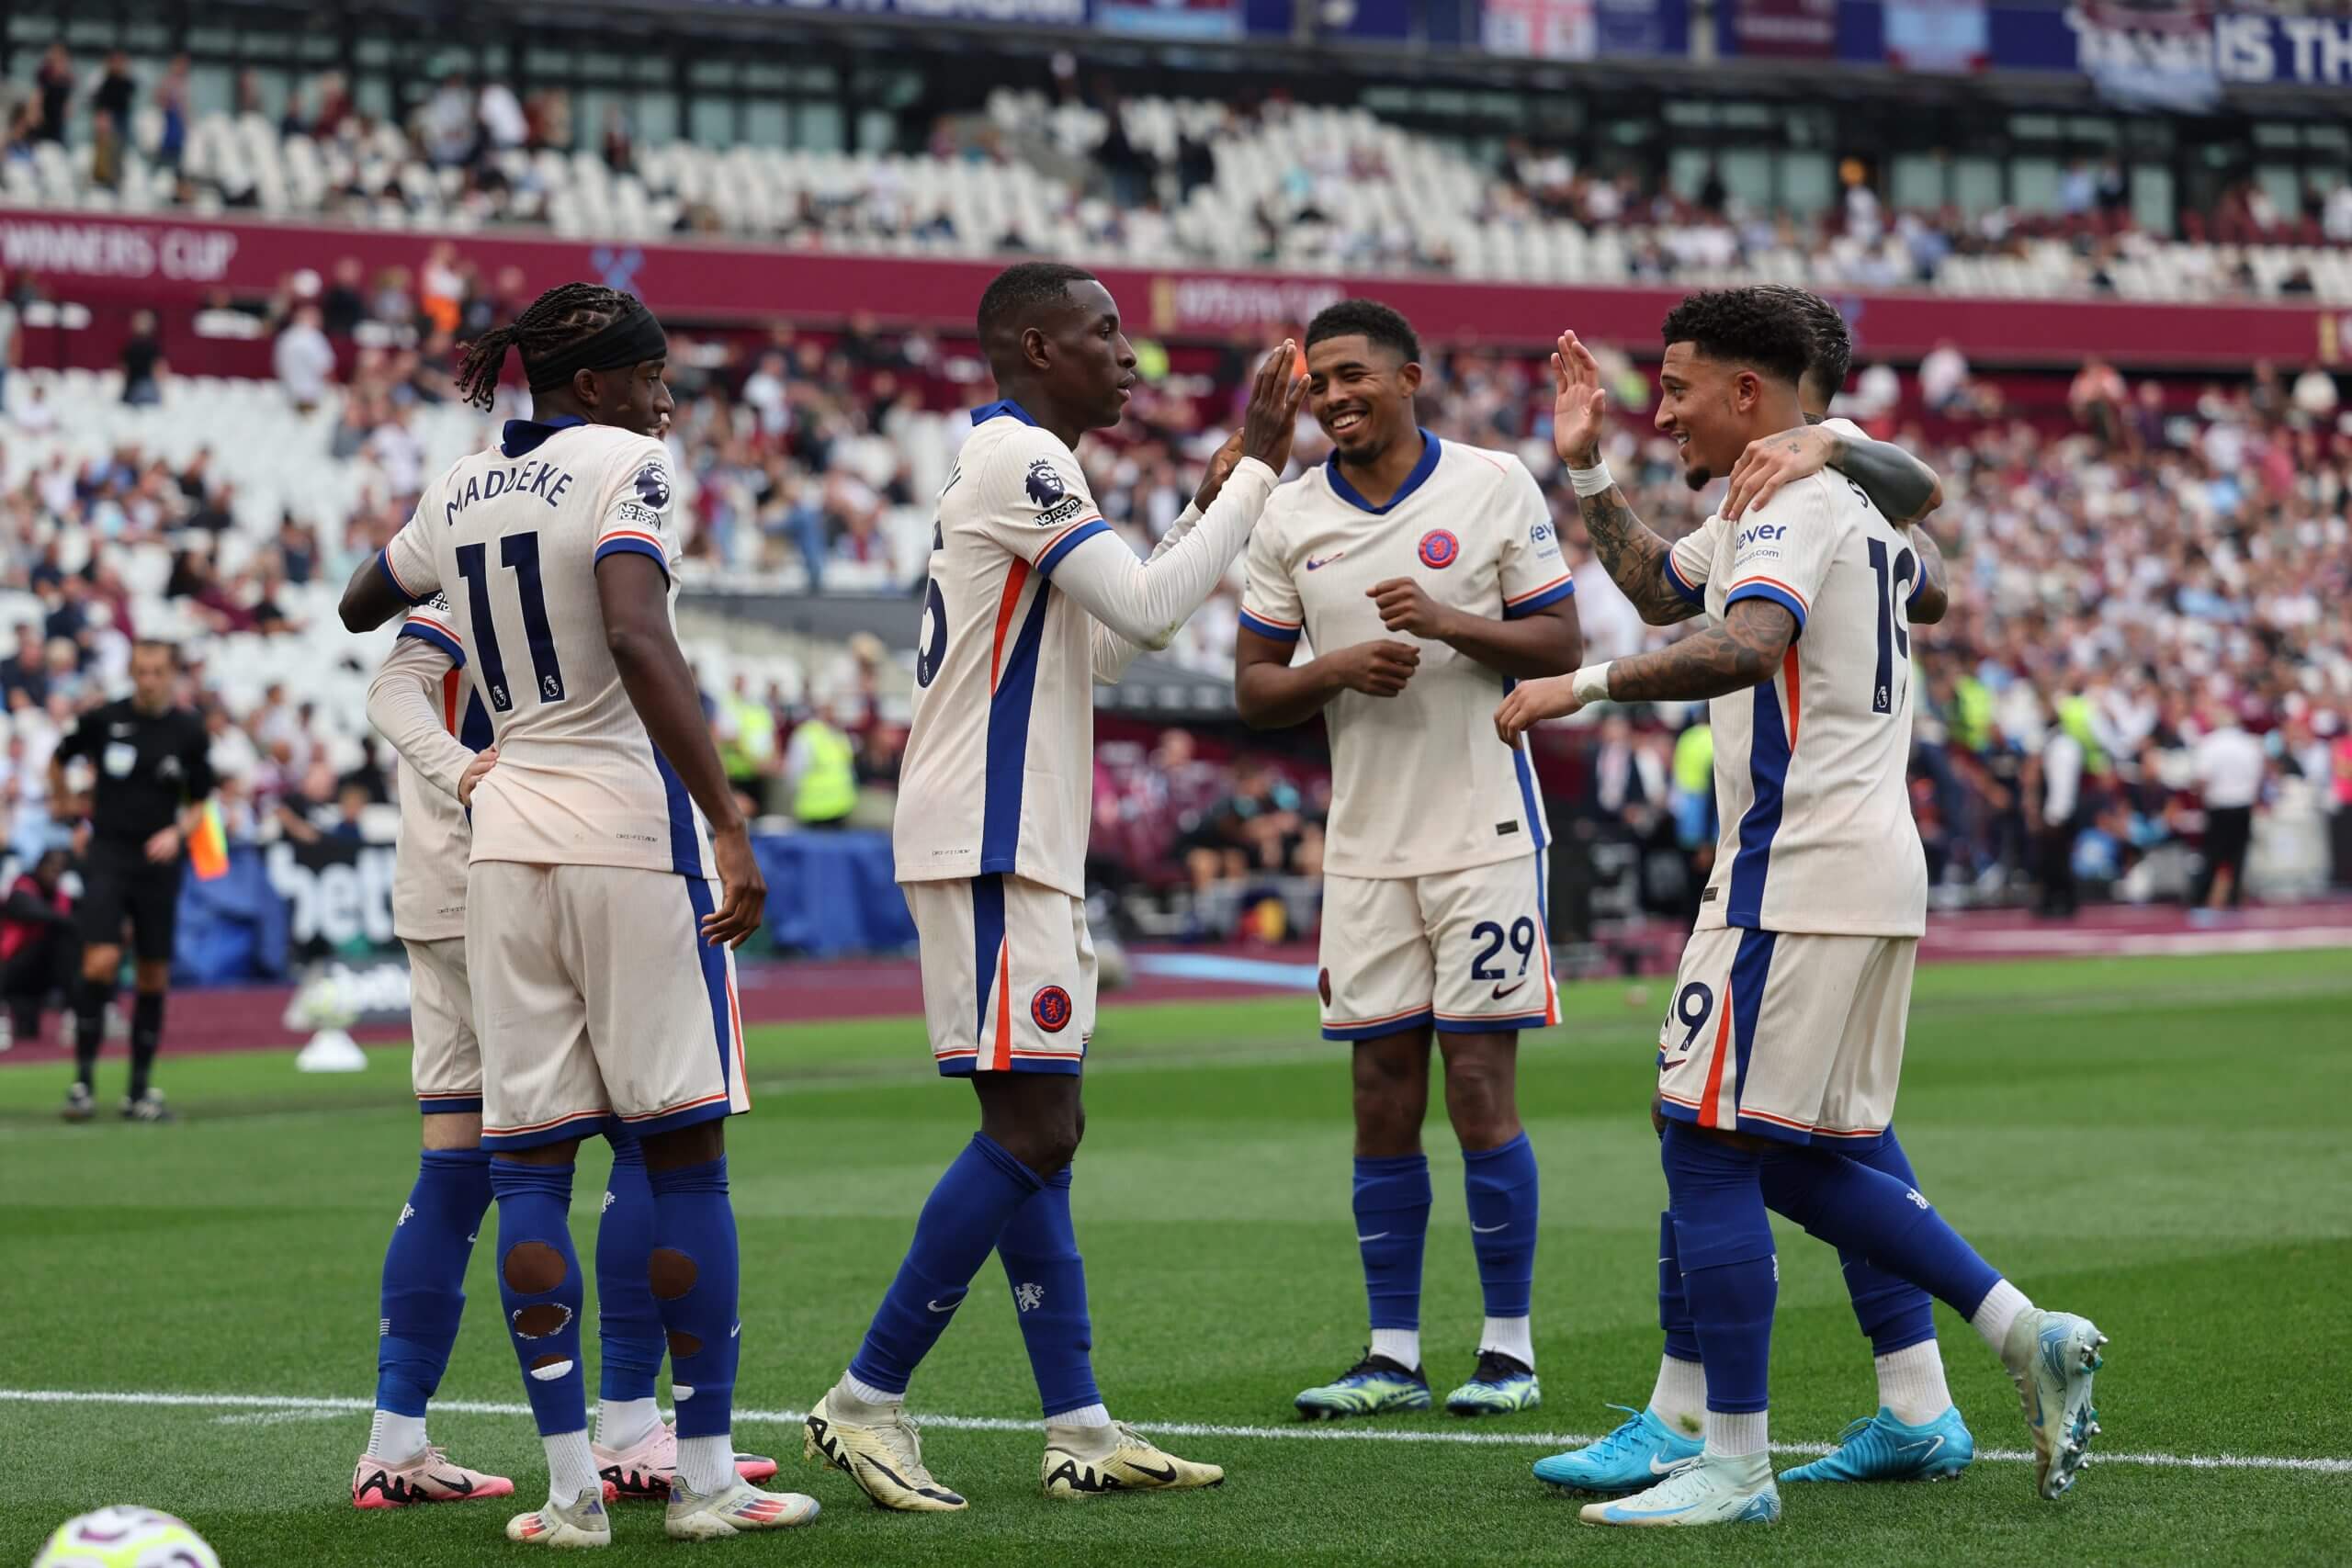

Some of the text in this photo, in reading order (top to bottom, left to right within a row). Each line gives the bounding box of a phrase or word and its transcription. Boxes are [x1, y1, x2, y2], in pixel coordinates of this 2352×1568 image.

[2213, 13, 2276, 83] IS
[455, 530, 567, 714] 11
[1471, 916, 1534, 981] 29
[1665, 981, 1714, 1052] 9
